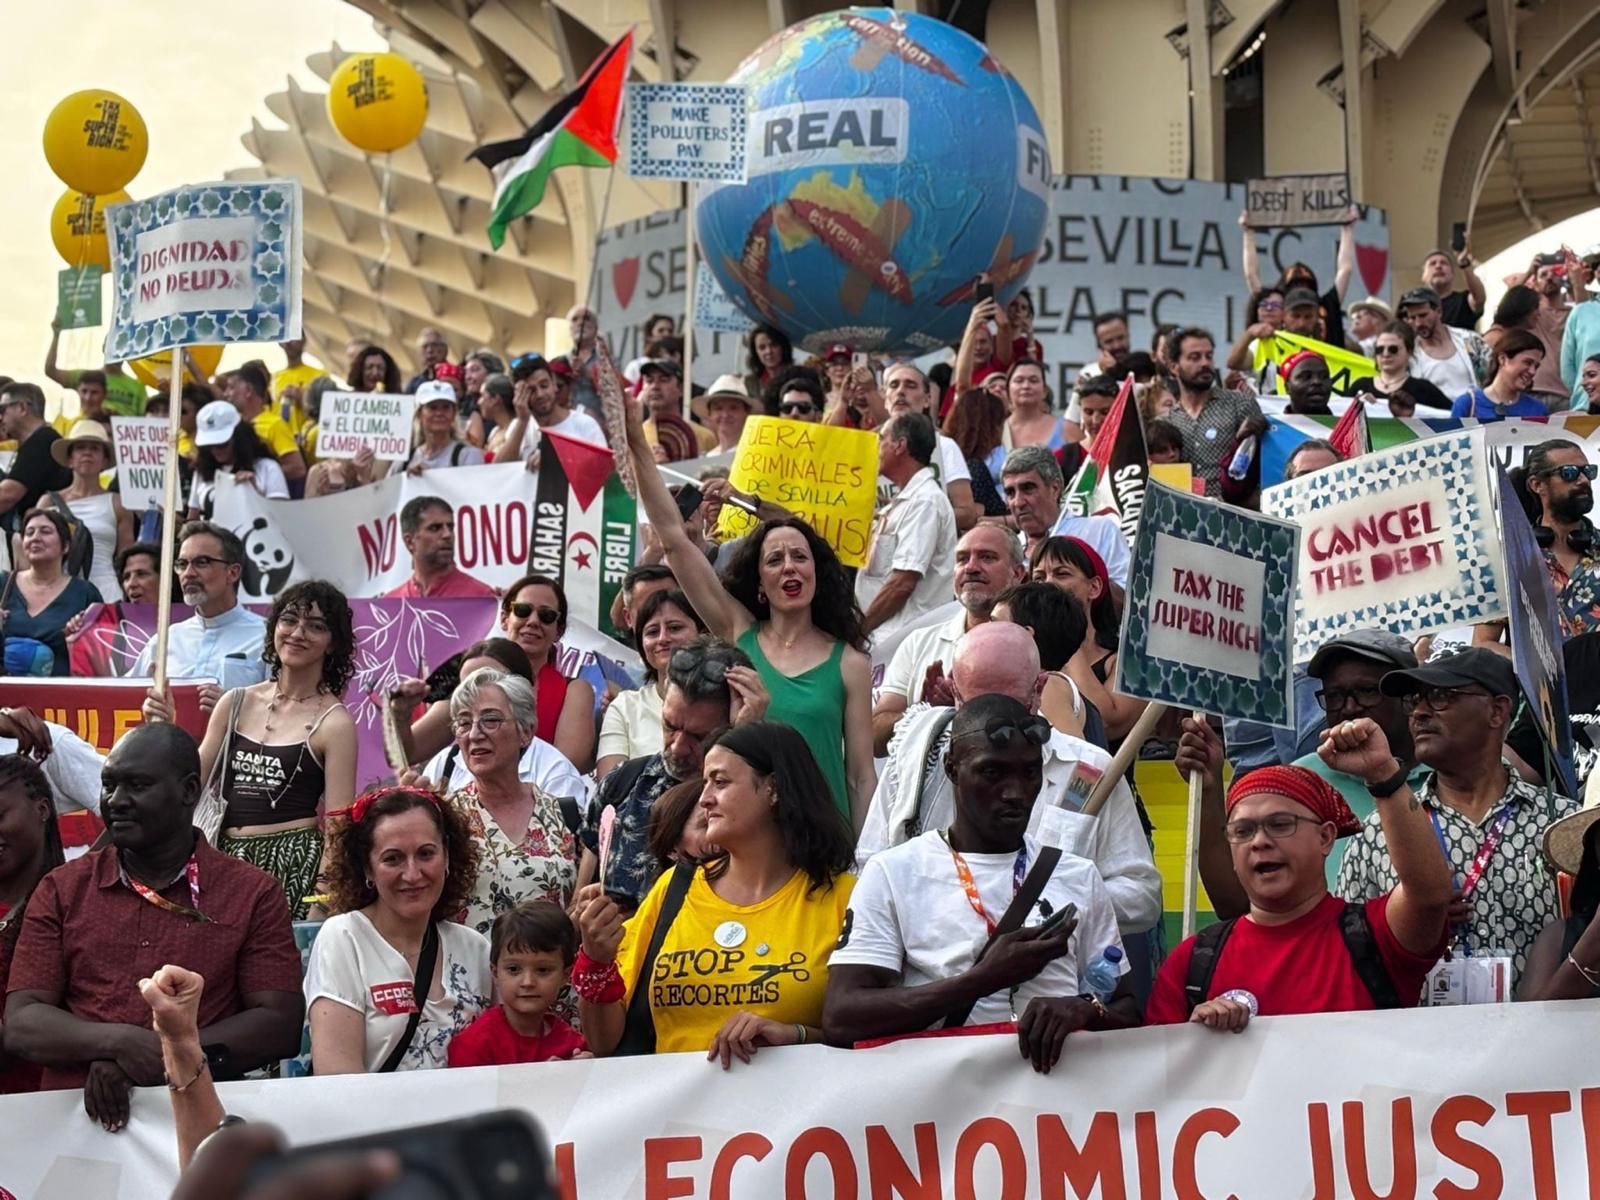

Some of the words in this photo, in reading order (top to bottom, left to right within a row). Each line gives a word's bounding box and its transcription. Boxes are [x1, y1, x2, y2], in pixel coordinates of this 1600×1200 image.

[849, 16, 931, 66] corrtion
[672, 107, 710, 122] MAKE
[651, 125, 728, 141] POLLUTERS
[763, 108, 897, 157] REAL
[677, 143, 702, 158] PAY
[1302, 189, 1348, 212] KILLS
[141, 239, 249, 275] DIGNIDAD
[1037, 214, 1230, 271] EVILLA
[140, 278, 161, 304] NO
[166, 268, 249, 294] DEUDA
[333, 397, 351, 414] NO
[353, 398, 401, 416] CAMBIA
[116, 424, 147, 442] SAVE
[336, 416, 349, 433] EL
[119, 444, 169, 466] PLANE
[373, 436, 406, 455] TODO
[740, 452, 863, 488] CRIMINALES
[776, 482, 848, 508] SEVILLA
[357, 512, 397, 581] NO
[457, 501, 528, 569] ONO
[1307, 501, 1441, 562] CANCEL
[1310, 560, 1364, 595] THE
[1371, 540, 1444, 583] DEBT
[1172, 567, 1212, 601] TAX
[1216, 579, 1245, 612] THE
[1152, 599, 1215, 640] SUPER
[1218, 616, 1260, 654] RICH
[231, 760, 287, 780] MONICA
[235, 750, 282, 768] SANTA
[654, 948, 745, 984] STOP
[653, 980, 780, 1008] RECORTES
[643, 1107, 1241, 1200] ECONOMIC
